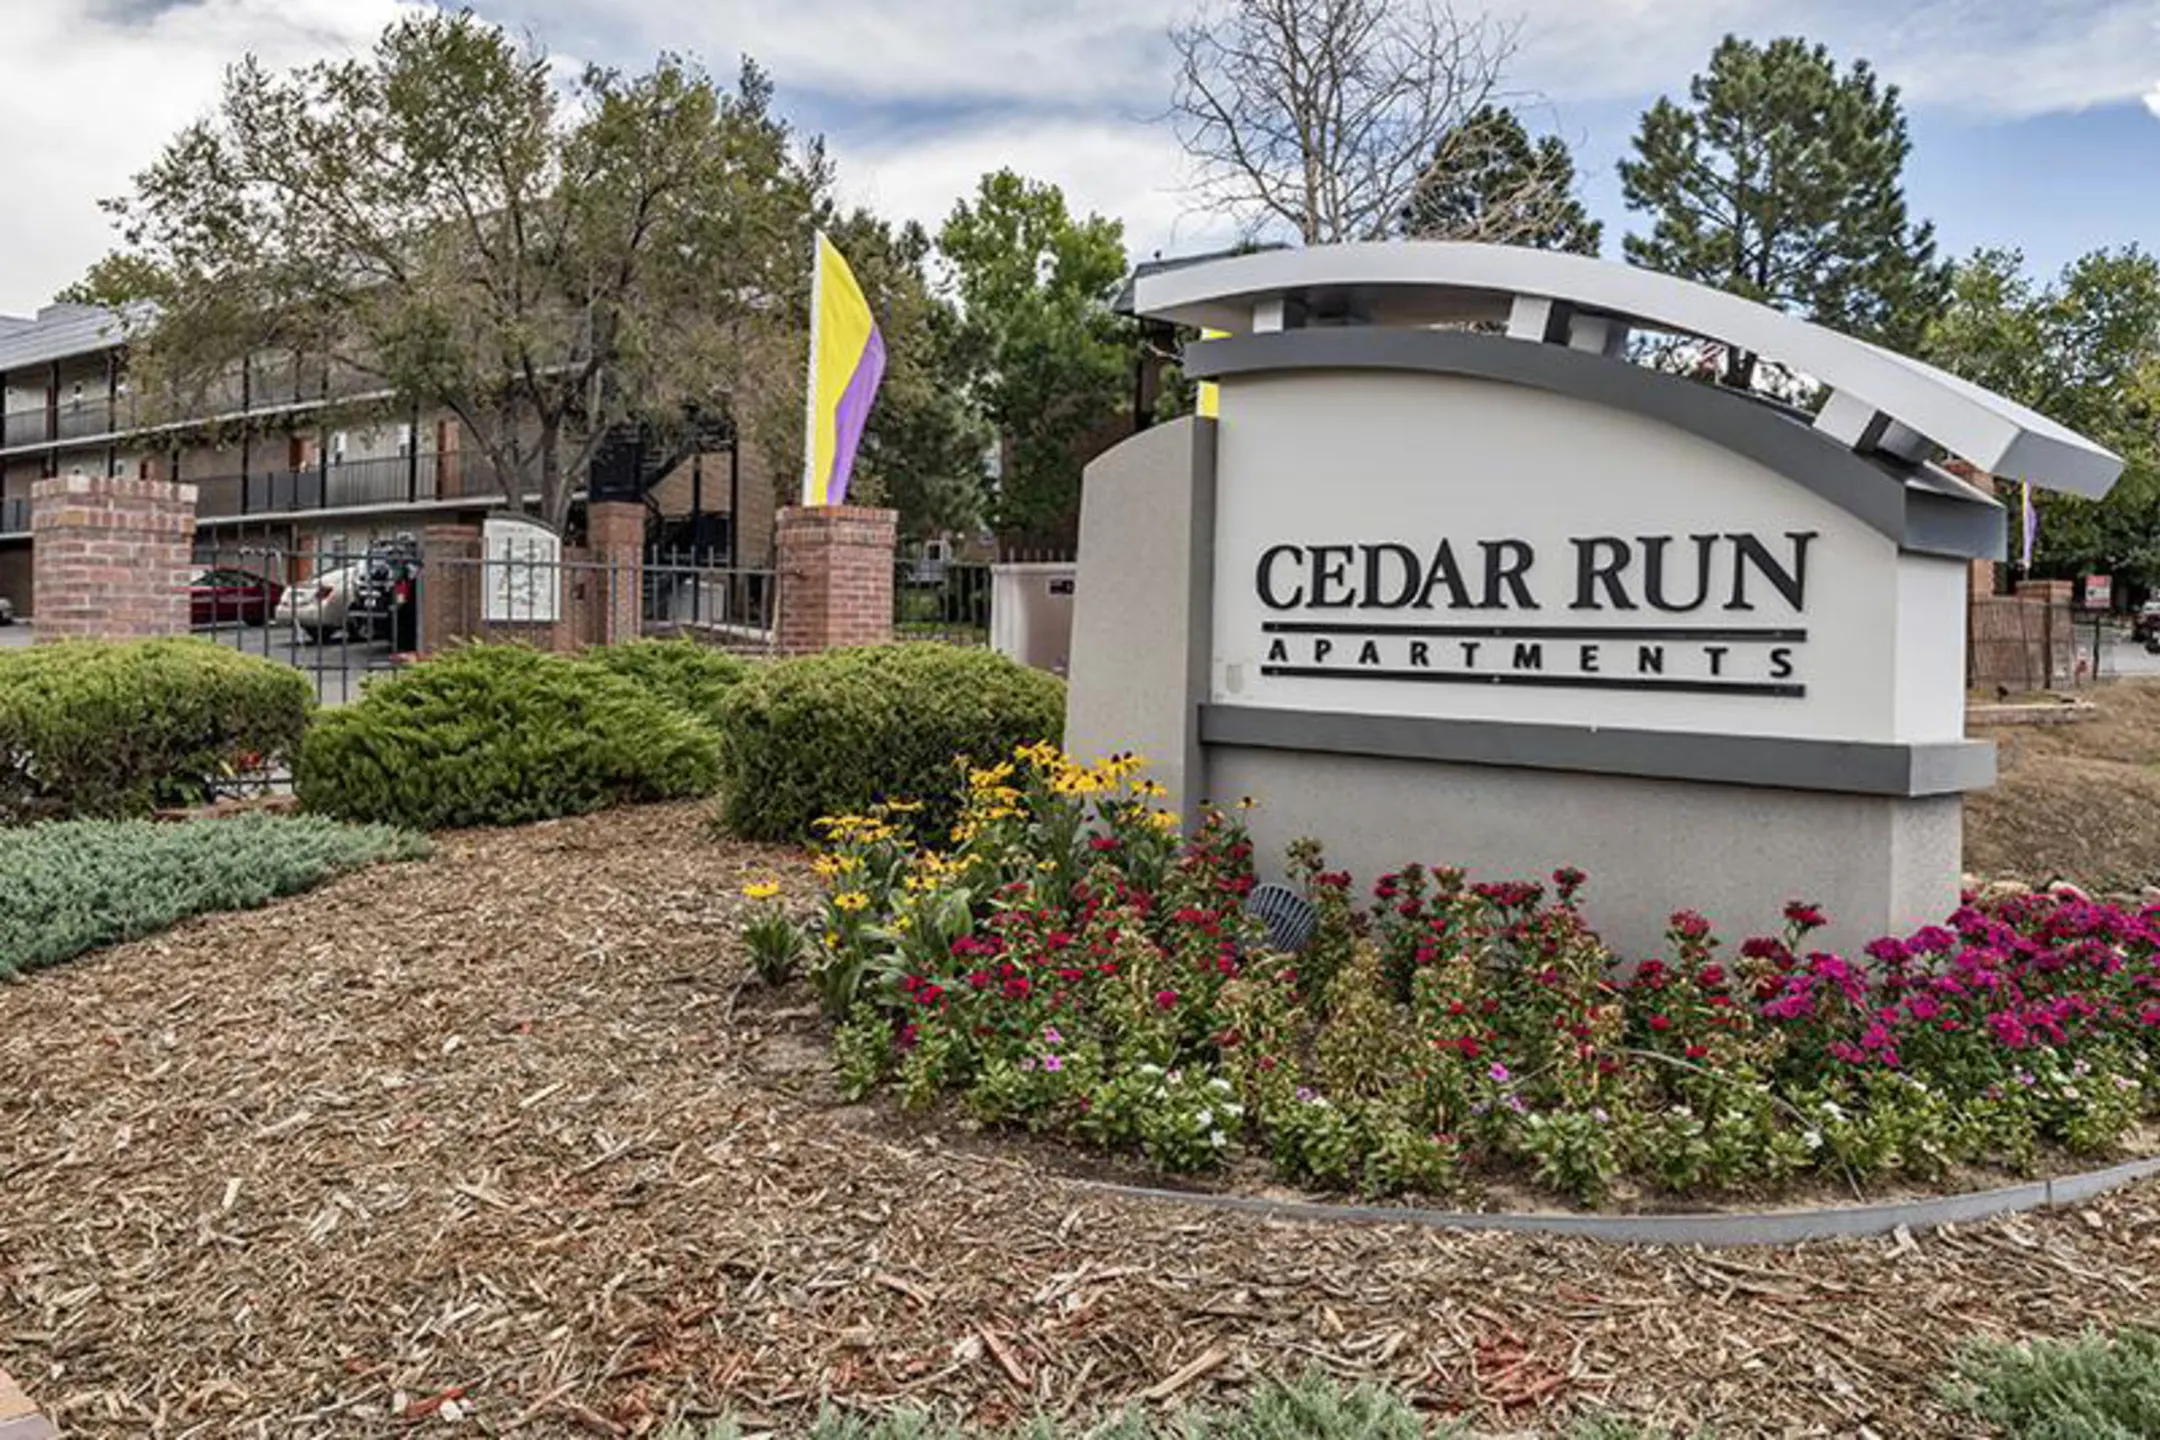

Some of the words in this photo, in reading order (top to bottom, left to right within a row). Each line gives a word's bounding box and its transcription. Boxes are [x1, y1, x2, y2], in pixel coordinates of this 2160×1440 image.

[1256, 538, 1540, 611] CEDAR
[1569, 531, 1818, 613] RUN
[1268, 639, 1793, 679] APARTMENTS
